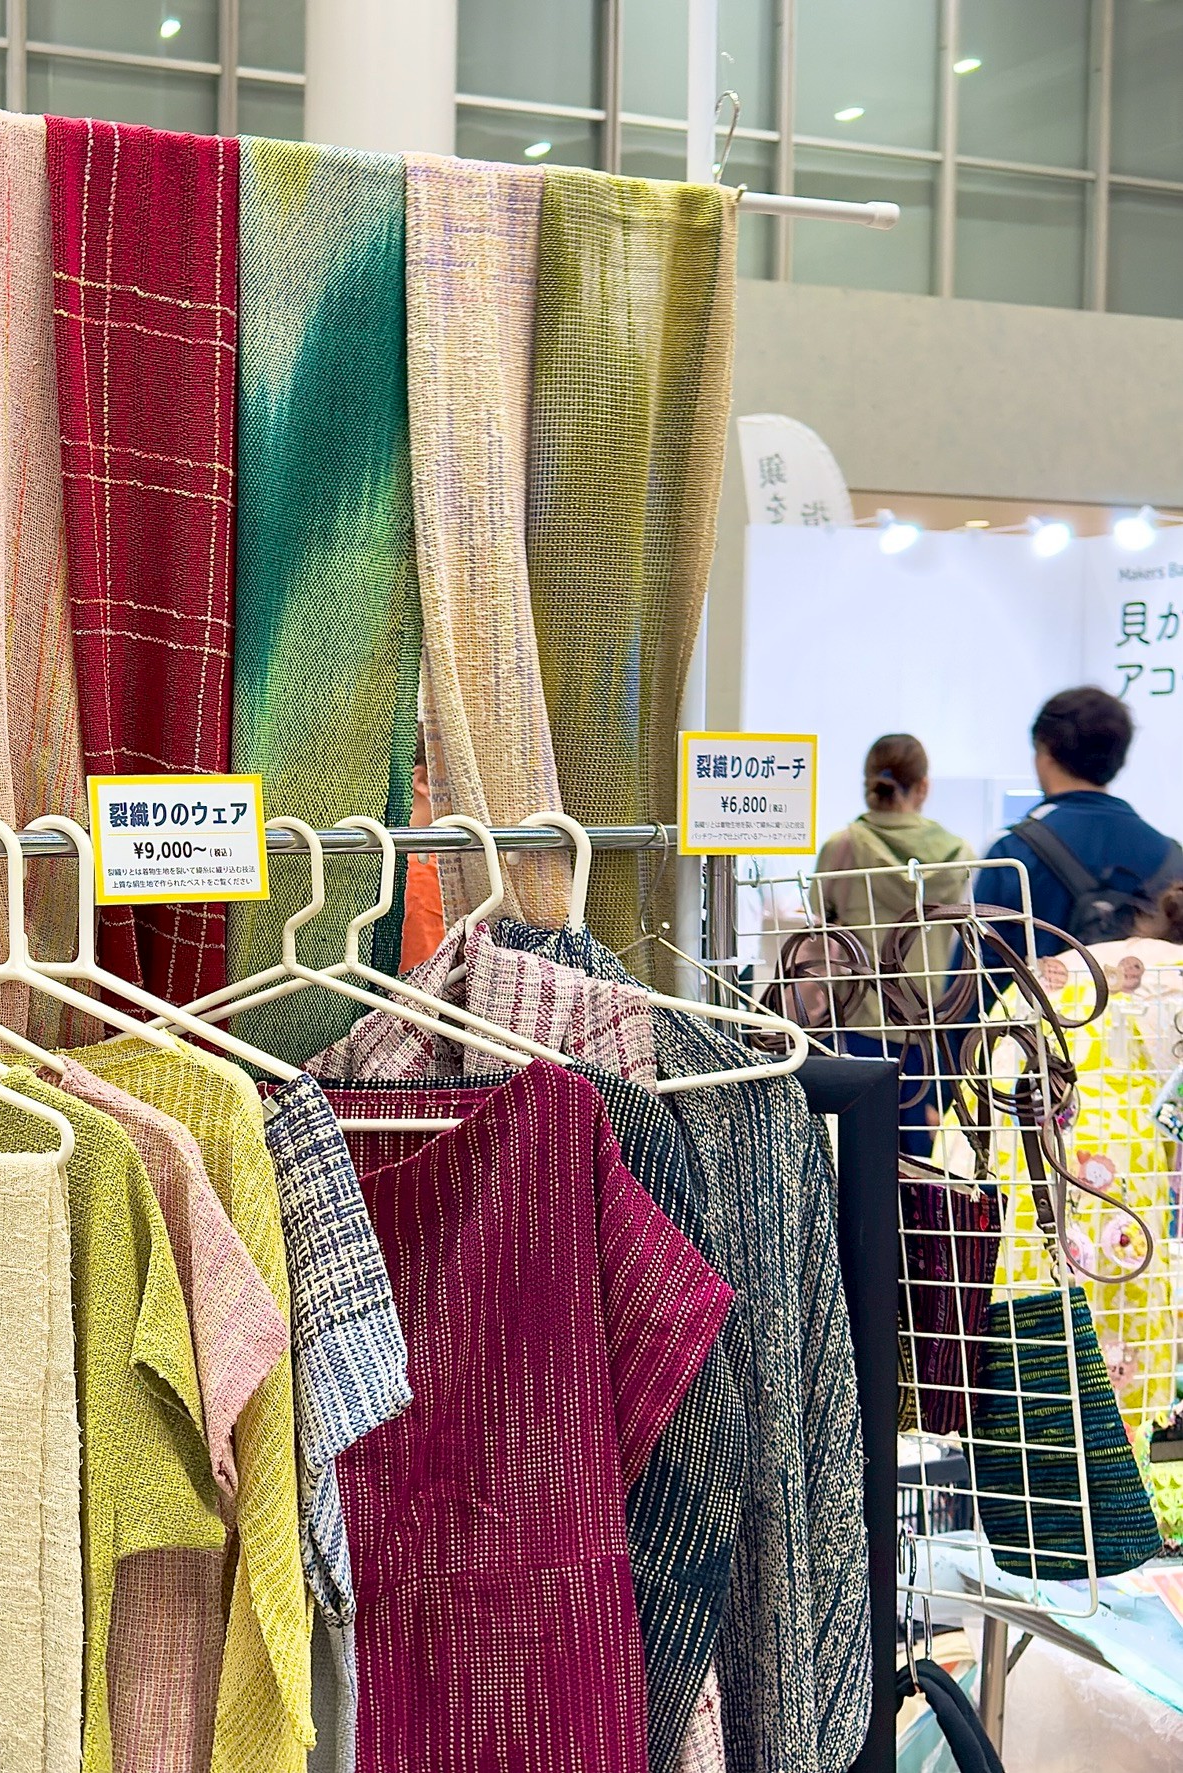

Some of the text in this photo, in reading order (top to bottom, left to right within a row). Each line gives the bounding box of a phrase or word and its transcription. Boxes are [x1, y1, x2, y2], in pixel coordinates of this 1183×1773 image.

[696, 754, 806, 779] 裂織りのポーチ
[109, 801, 248, 828] 裂織りのウェア
[721, 796, 767, 814] ¥6,800
